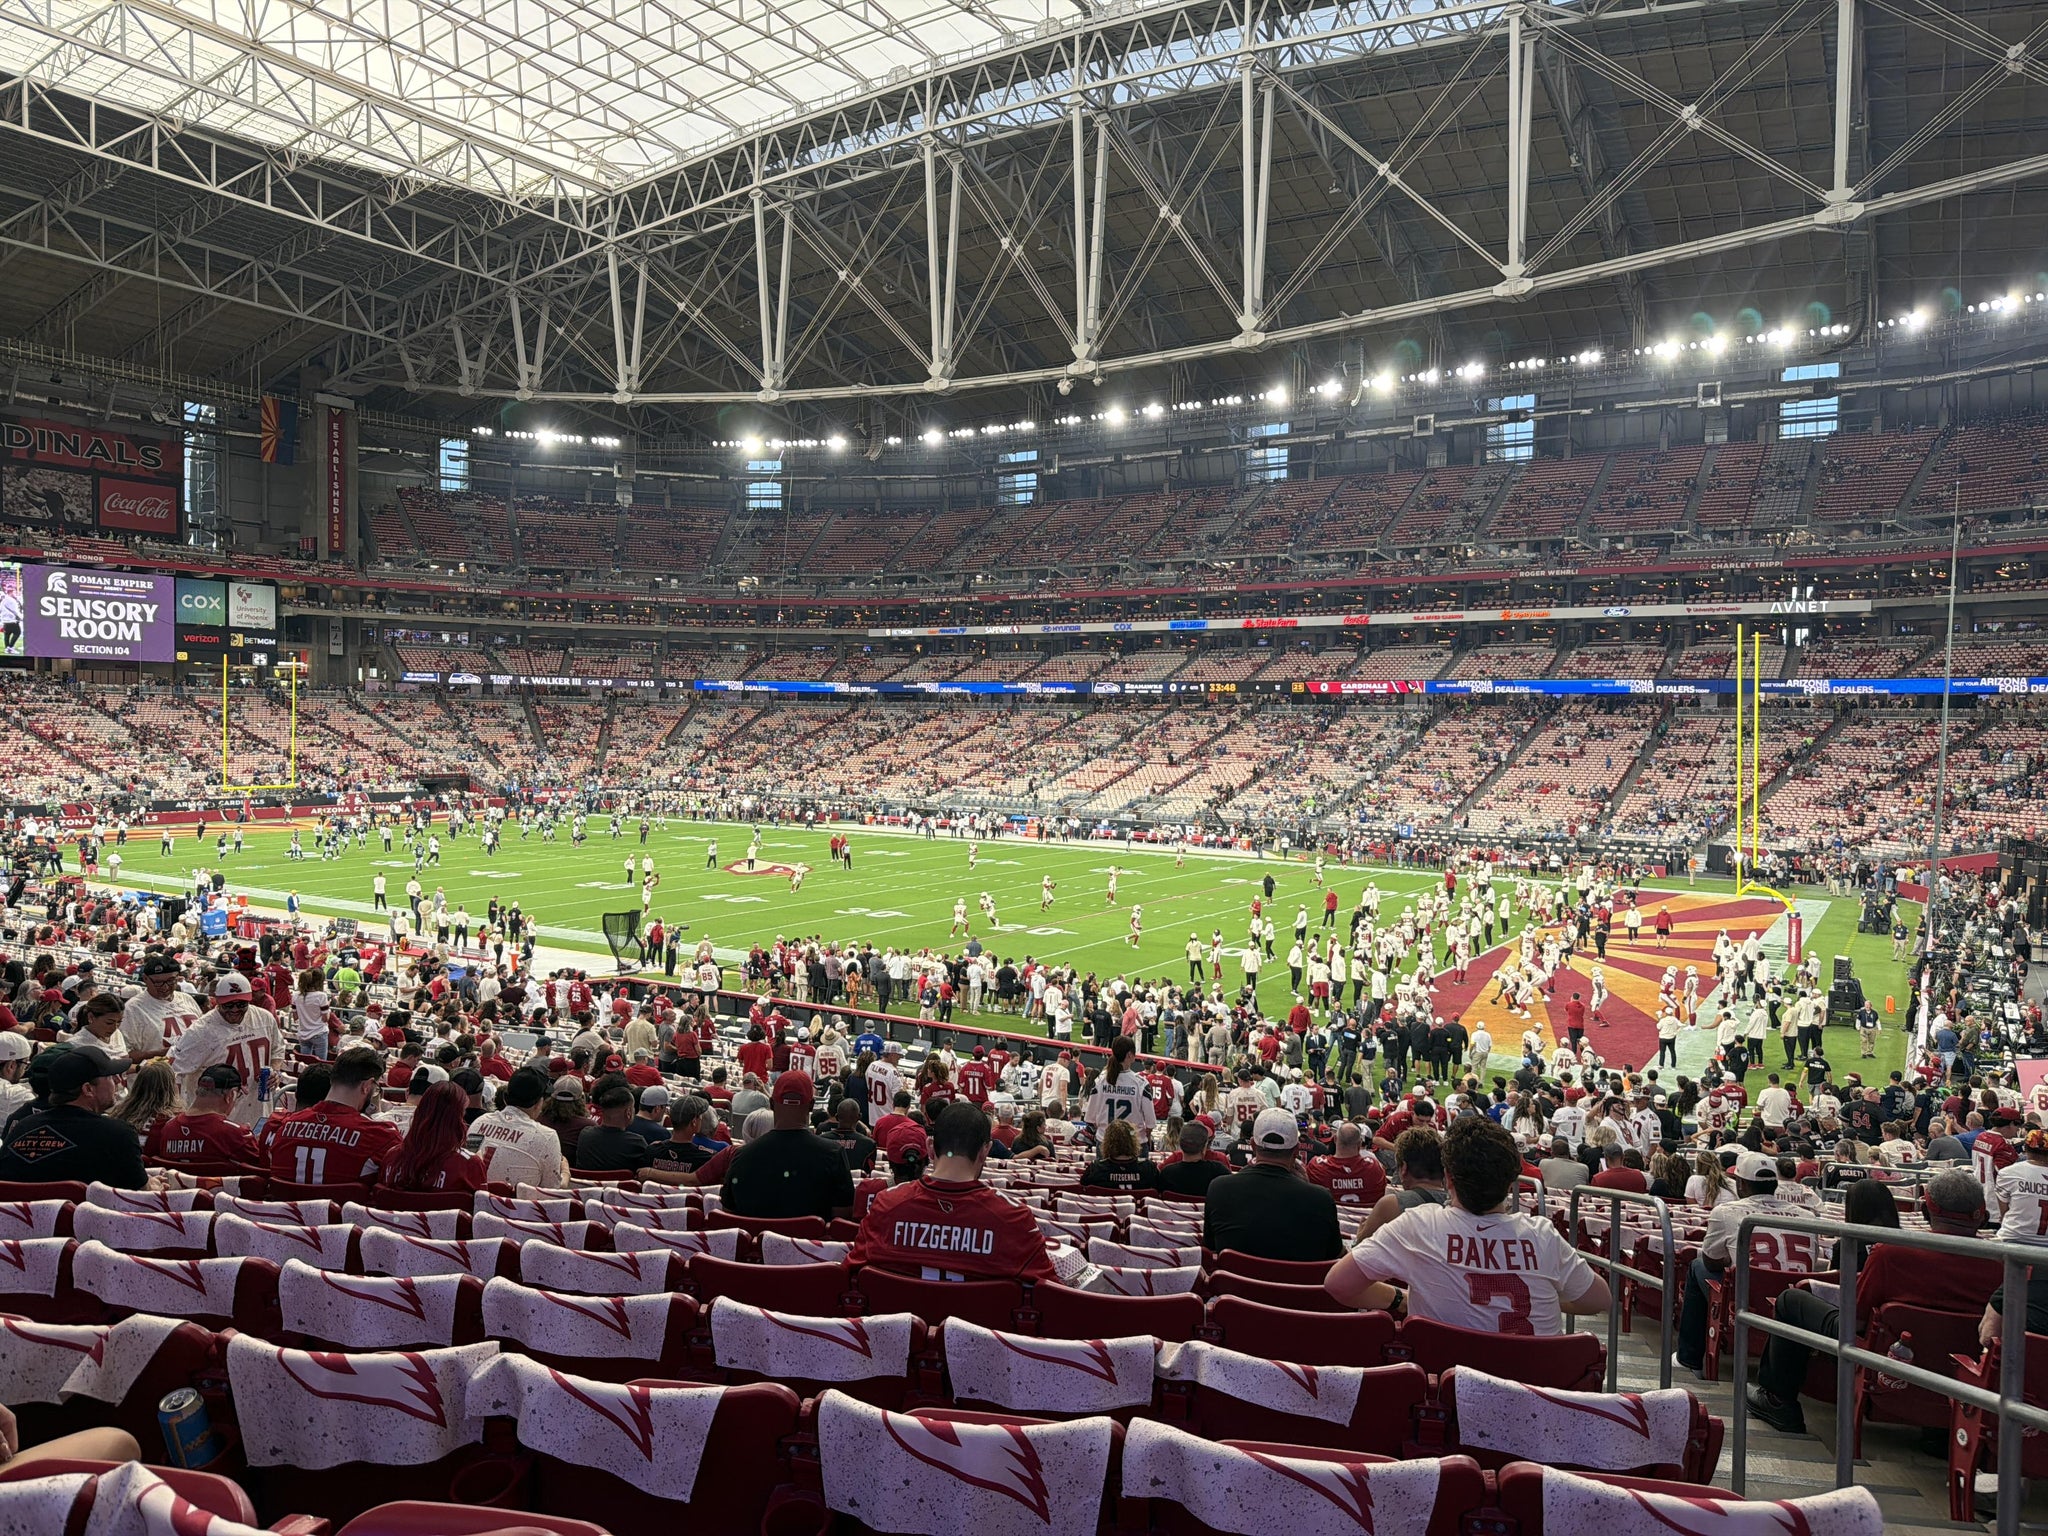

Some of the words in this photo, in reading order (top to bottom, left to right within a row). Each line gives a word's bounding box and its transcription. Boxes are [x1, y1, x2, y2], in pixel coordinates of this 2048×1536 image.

[0, 421, 164, 470] DINALS
[332, 422, 341, 514] ESTABLISHED
[104, 493, 171, 519] Coca-Cola
[77, 554, 104, 562] HONOR
[1710, 562, 1751, 570] CHARLEY
[72, 575, 111, 586] ROMAN
[113, 579, 154, 590] EMPIRE
[181, 594, 222, 610] COX
[1770, 601, 1829, 613] AVNET
[40, 596, 159, 623] SENSORY
[236, 605, 267, 614] University
[244, 613, 269, 621] Phoenix
[1254, 619, 1276, 628] State
[1277, 618, 1298, 626] Farm
[60, 618, 142, 641] ROOM
[985, 626, 1012, 635] SAFEWAY
[1113, 623, 1132, 631] COX
[183, 634, 220, 644] verizon
[244, 637, 276, 646] BETMGM
[73, 645, 113, 655] SECTION
[115, 647, 130, 656] 104
[254, 655, 267, 666] 25
[519, 676, 529, 684] K.
[530, 677, 570, 685] WALKER
[571, 678, 582, 686] III
[1456, 680, 1492, 688] ARIZONA
[1786, 679, 1829, 687] ARIZONA
[1979, 678, 2027, 686] ARIZONA
[1169, 683, 1177, 692] 0
[1199, 683, 1205, 692] 1
[1209, 684, 1236, 692] 33:48
[1320, 683, 1328, 692] 0
[1803, 686, 1831, 694] FORD
[1999, 685, 2028, 693] FORD
[702, 972, 713, 981] 85
[571, 991, 582, 1002] 25
[790, 1056, 805, 1071] 81
[818, 1057, 837, 1075] 85
[993, 1060, 1000, 1074] 11
[1557, 1058, 1571, 1069] 40
[1045, 1072, 1053, 1088] 6
[866, 1077, 886, 1107] 40
[968, 1078, 980, 1095] 11
[1152, 1086, 1162, 1099] 15
[1293, 1097, 1301, 1110] 3
[1325, 1094, 1335, 1107] 11
[1892, 1097, 1903, 1115] 3
[1105, 1098, 1132, 1125] 12
[1236, 1104, 1258, 1122] 85
[1828, 1106, 1836, 1117] 3
[1852, 1111, 1872, 1130] 54
[281, 1121, 361, 1148] FITZGERALD
[477, 1123, 524, 1144] MURRAY
[1571, 1122, 1577, 1137] 1
[13, 1140, 38, 1148] SALTY
[39, 1140, 66, 1148] CREW
[166, 1139, 205, 1154] MURRAY
[294, 1145, 327, 1186] 11
[652, 1157, 693, 1173] MURRAY
[1978, 1156, 1986, 1184] 1
[1109, 1173, 1140, 1182] FITZGERALD
[1839, 1169, 1864, 1179] DOCKETT
[1331, 1178, 1364, 1190] CONNER
[1775, 1193, 1806, 1205] TILLMAN
[893, 1221, 994, 1256] FITZGERALD
[1446, 1233, 1539, 1271] BAKER
[1748, 1232, 1812, 1273] 85
[1463, 1272, 1536, 1337] 3
